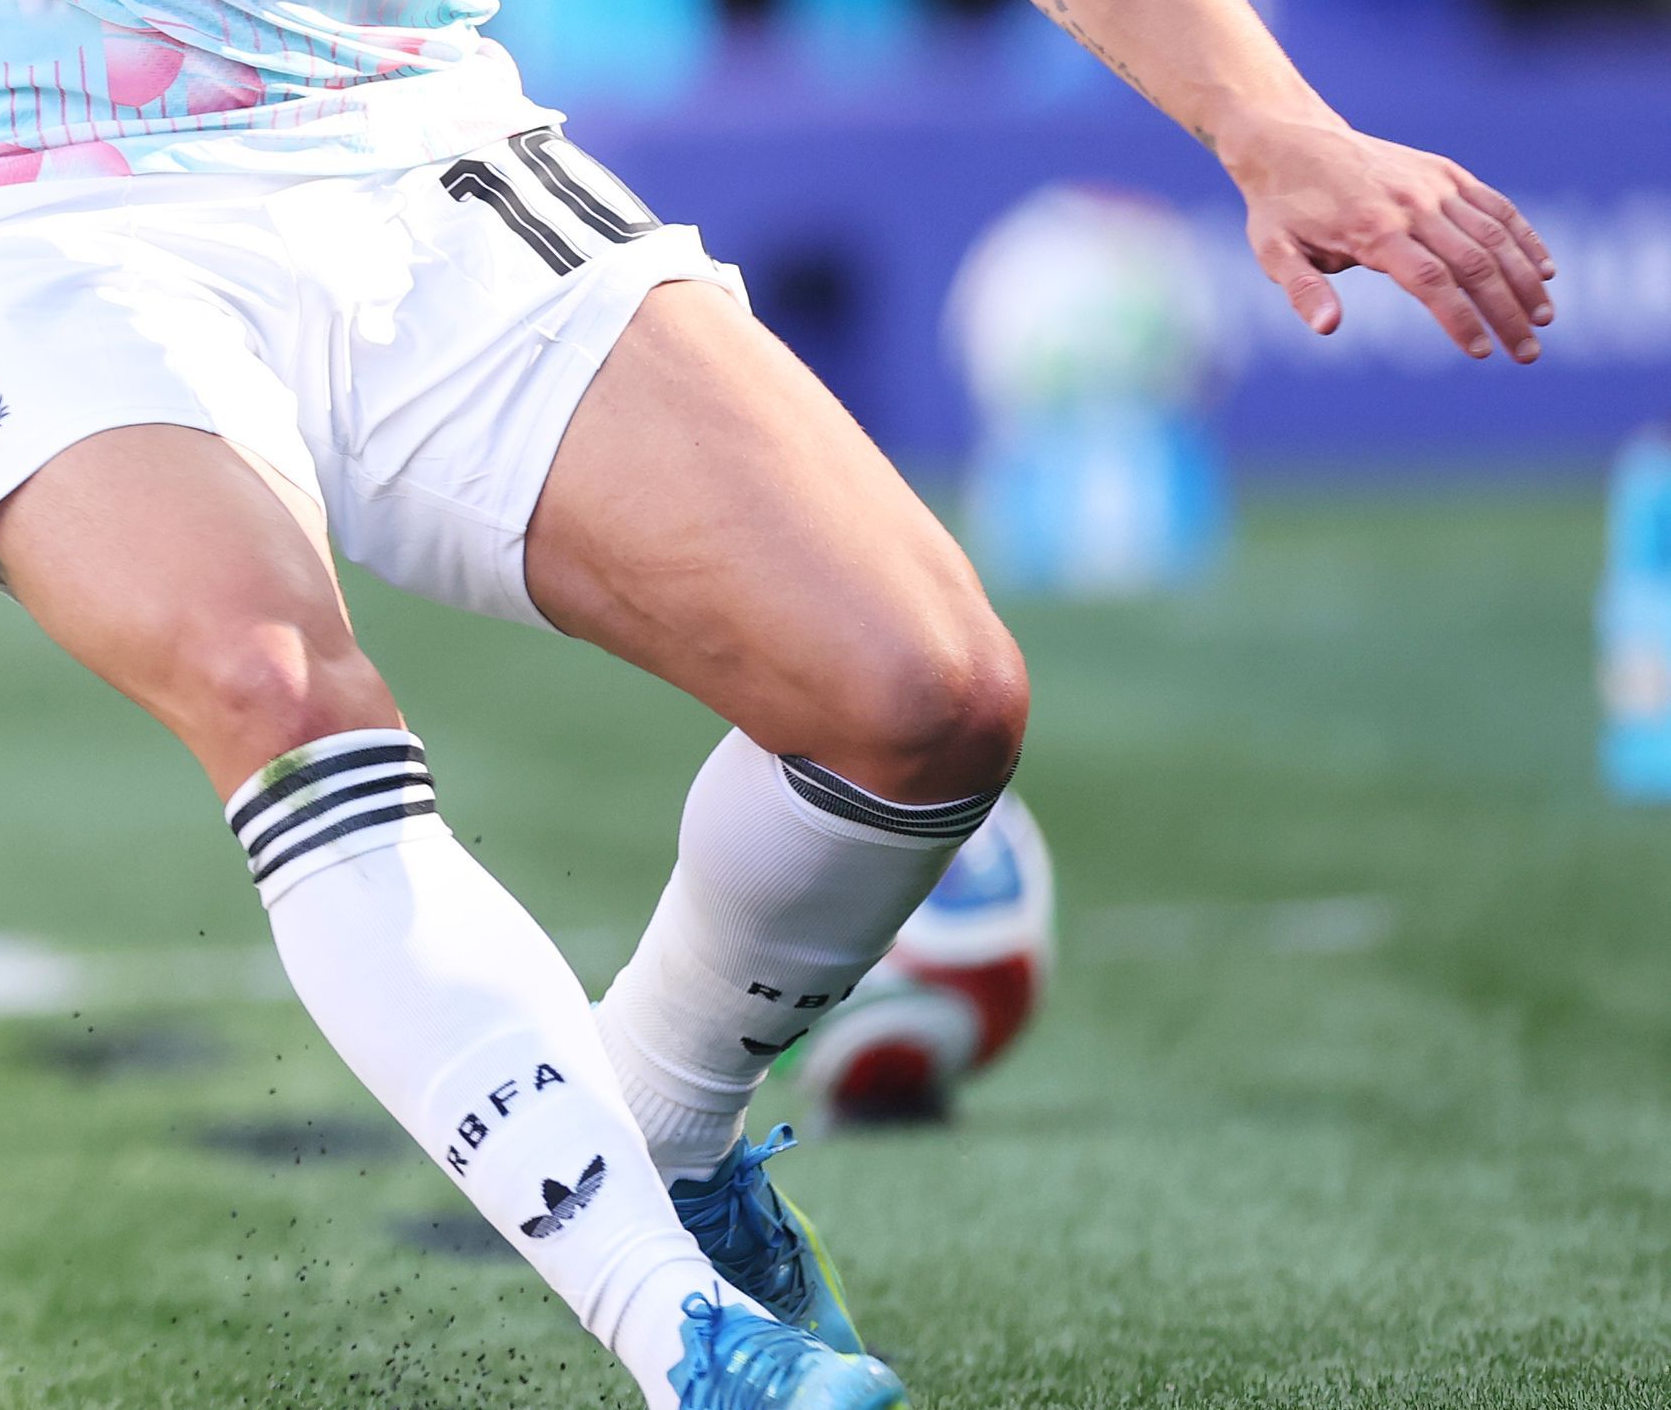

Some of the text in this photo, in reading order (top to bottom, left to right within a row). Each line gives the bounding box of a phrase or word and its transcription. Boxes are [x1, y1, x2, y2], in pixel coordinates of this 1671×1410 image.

[439, 125, 663, 277] 10
[747, 981, 858, 1009] RB
[447, 1063, 566, 1178] RBFA
